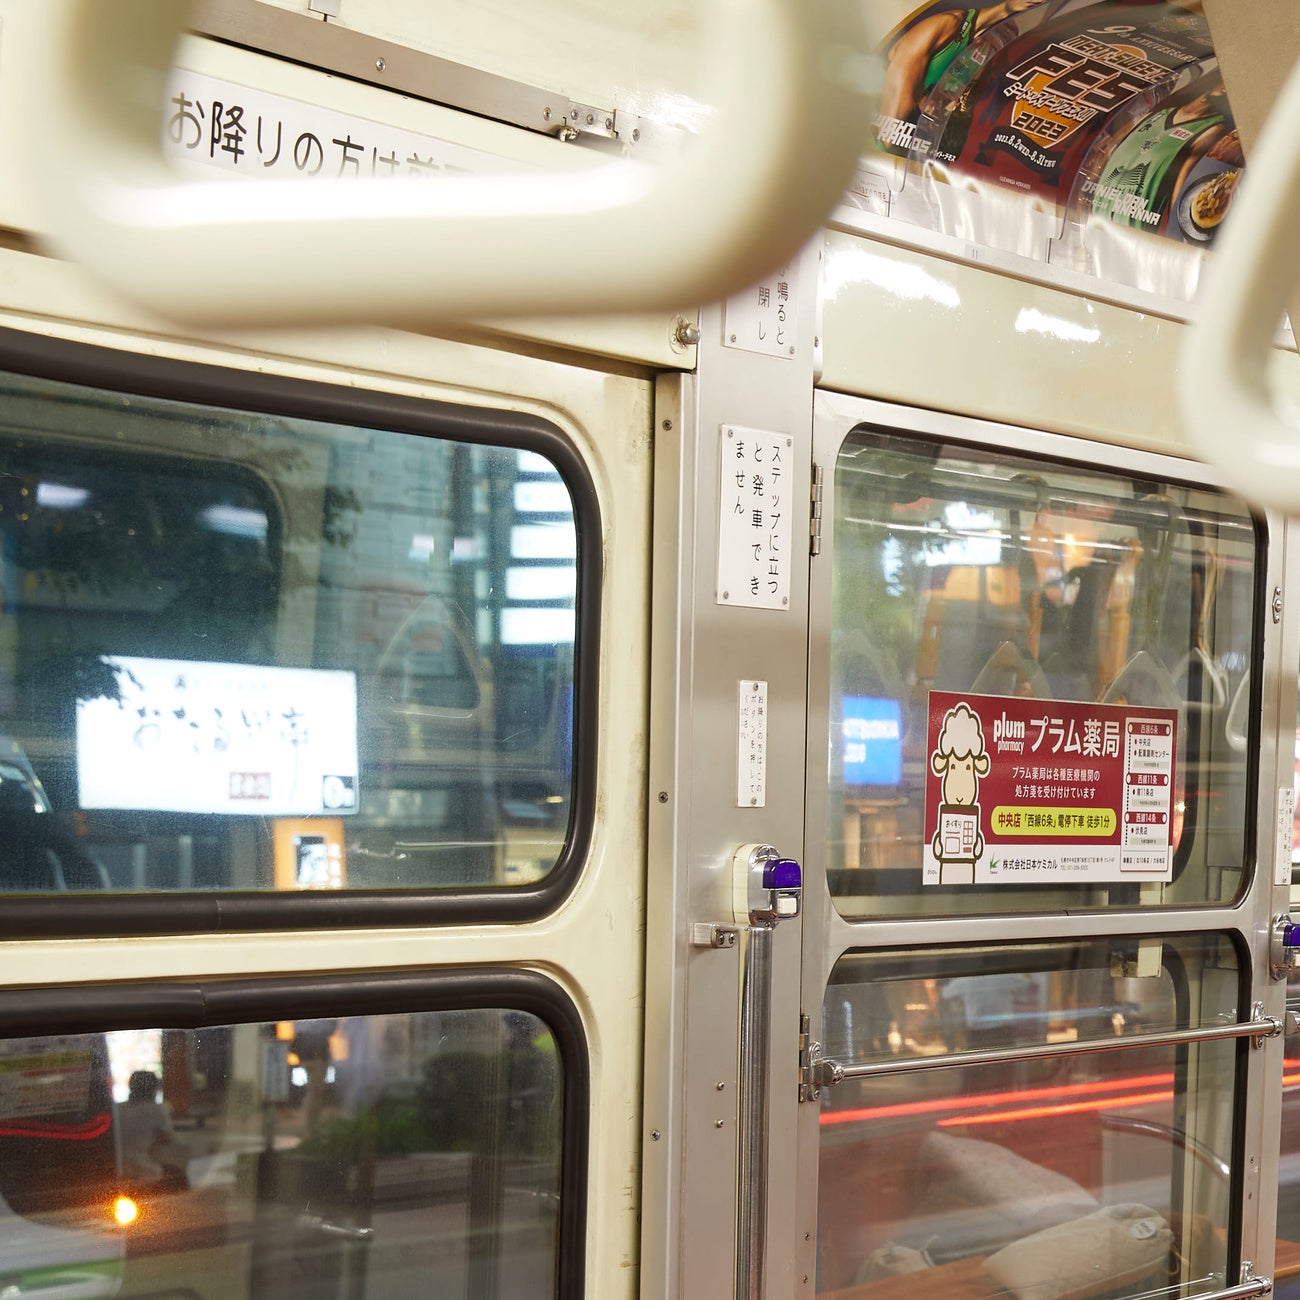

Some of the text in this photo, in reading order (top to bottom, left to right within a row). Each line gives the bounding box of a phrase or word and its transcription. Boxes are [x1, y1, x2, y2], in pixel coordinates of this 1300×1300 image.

[1005, 43, 1154, 113] FES
[877, 128, 932, 154] RAMOS
[1011, 111, 1069, 141] 2023
[733, 440, 745, 516] ません
[750, 442, 764, 596] と発車でき
[767, 445, 782, 595] ステップに立つ
[993, 712, 1025, 742] plum
[1030, 715, 1121, 759] プラム薬局
[997, 740, 1025, 756] pharmacy
[1012, 767, 1101, 782] プラム薬局は各種医療機関の
[1015, 784, 1097, 799] 処方箋を受け付けています
[1002, 858, 1059, 871] 株式会社日本ケミカル
